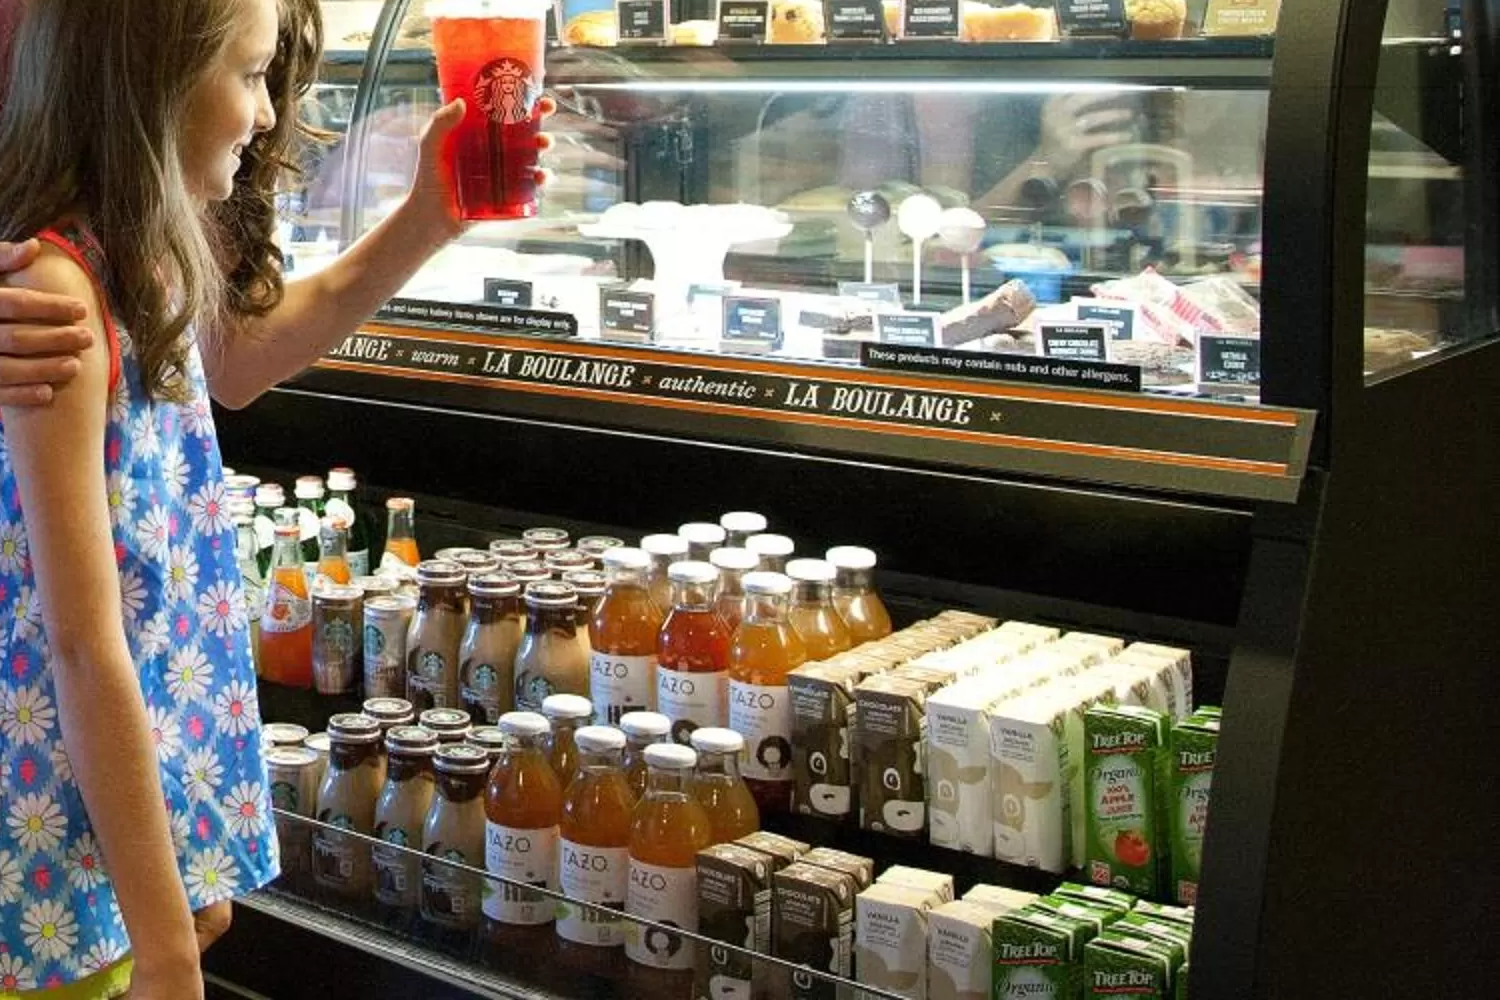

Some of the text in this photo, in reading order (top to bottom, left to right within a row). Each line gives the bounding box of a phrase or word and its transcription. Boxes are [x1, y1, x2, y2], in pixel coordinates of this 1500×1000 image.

[868, 348, 896, 362] These
[897, 350, 939, 366] products
[941, 356, 962, 369] may
[964, 356, 1002, 372] contain
[1002, 361, 1027, 374] nuts
[1028, 363, 1049, 376] and
[1051, 365, 1079, 378] other
[411, 348, 460, 367] warm
[482, 351, 512, 375] LA
[518, 354, 637, 389] BOULANGE
[658, 374, 757, 400] authentic
[784, 382, 820, 408] LA
[830, 386, 974, 425] BOULANGE
[591, 655, 629, 679] TAZO
[659, 672, 695, 697] TAZO
[730, 686, 775, 710] TAZO
[1092, 731, 1145, 748] TREE TOP
[1180, 751, 1213, 765] TREE
[489, 828, 531, 853] TAZO
[563, 847, 608, 872] TAZO
[631, 868, 667, 891] AZO
[1001, 942, 1057, 959] TREE TOP
[1094, 970, 1153, 987] TREE TOP
